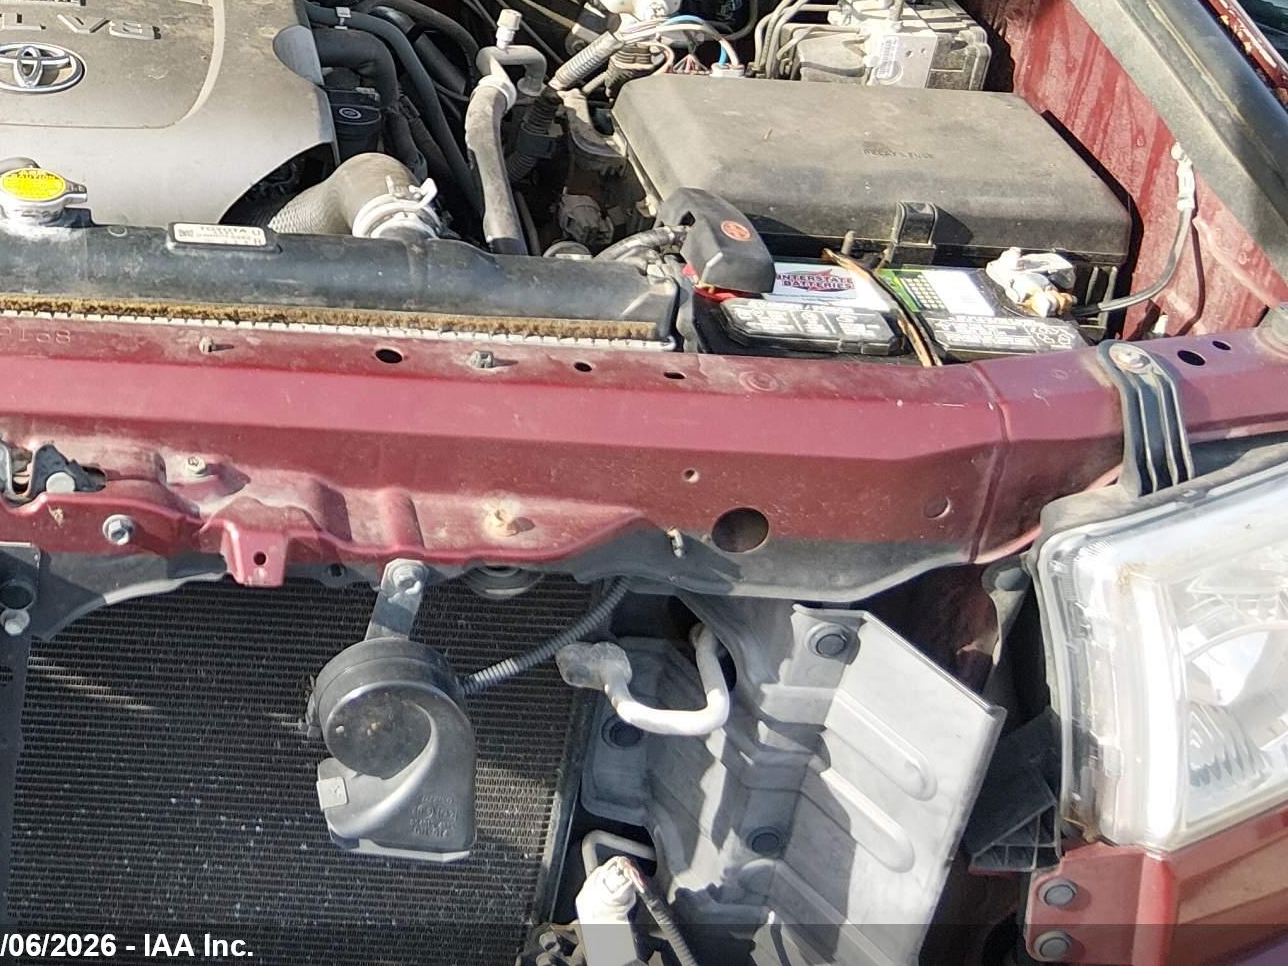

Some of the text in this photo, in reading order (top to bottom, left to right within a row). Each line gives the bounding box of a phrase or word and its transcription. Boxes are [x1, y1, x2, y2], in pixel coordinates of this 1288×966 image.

[57, 13, 161, 40] V8
[776, 274, 854, 284] INTERSTATE
[783, 280, 855, 290] BATTERIES
